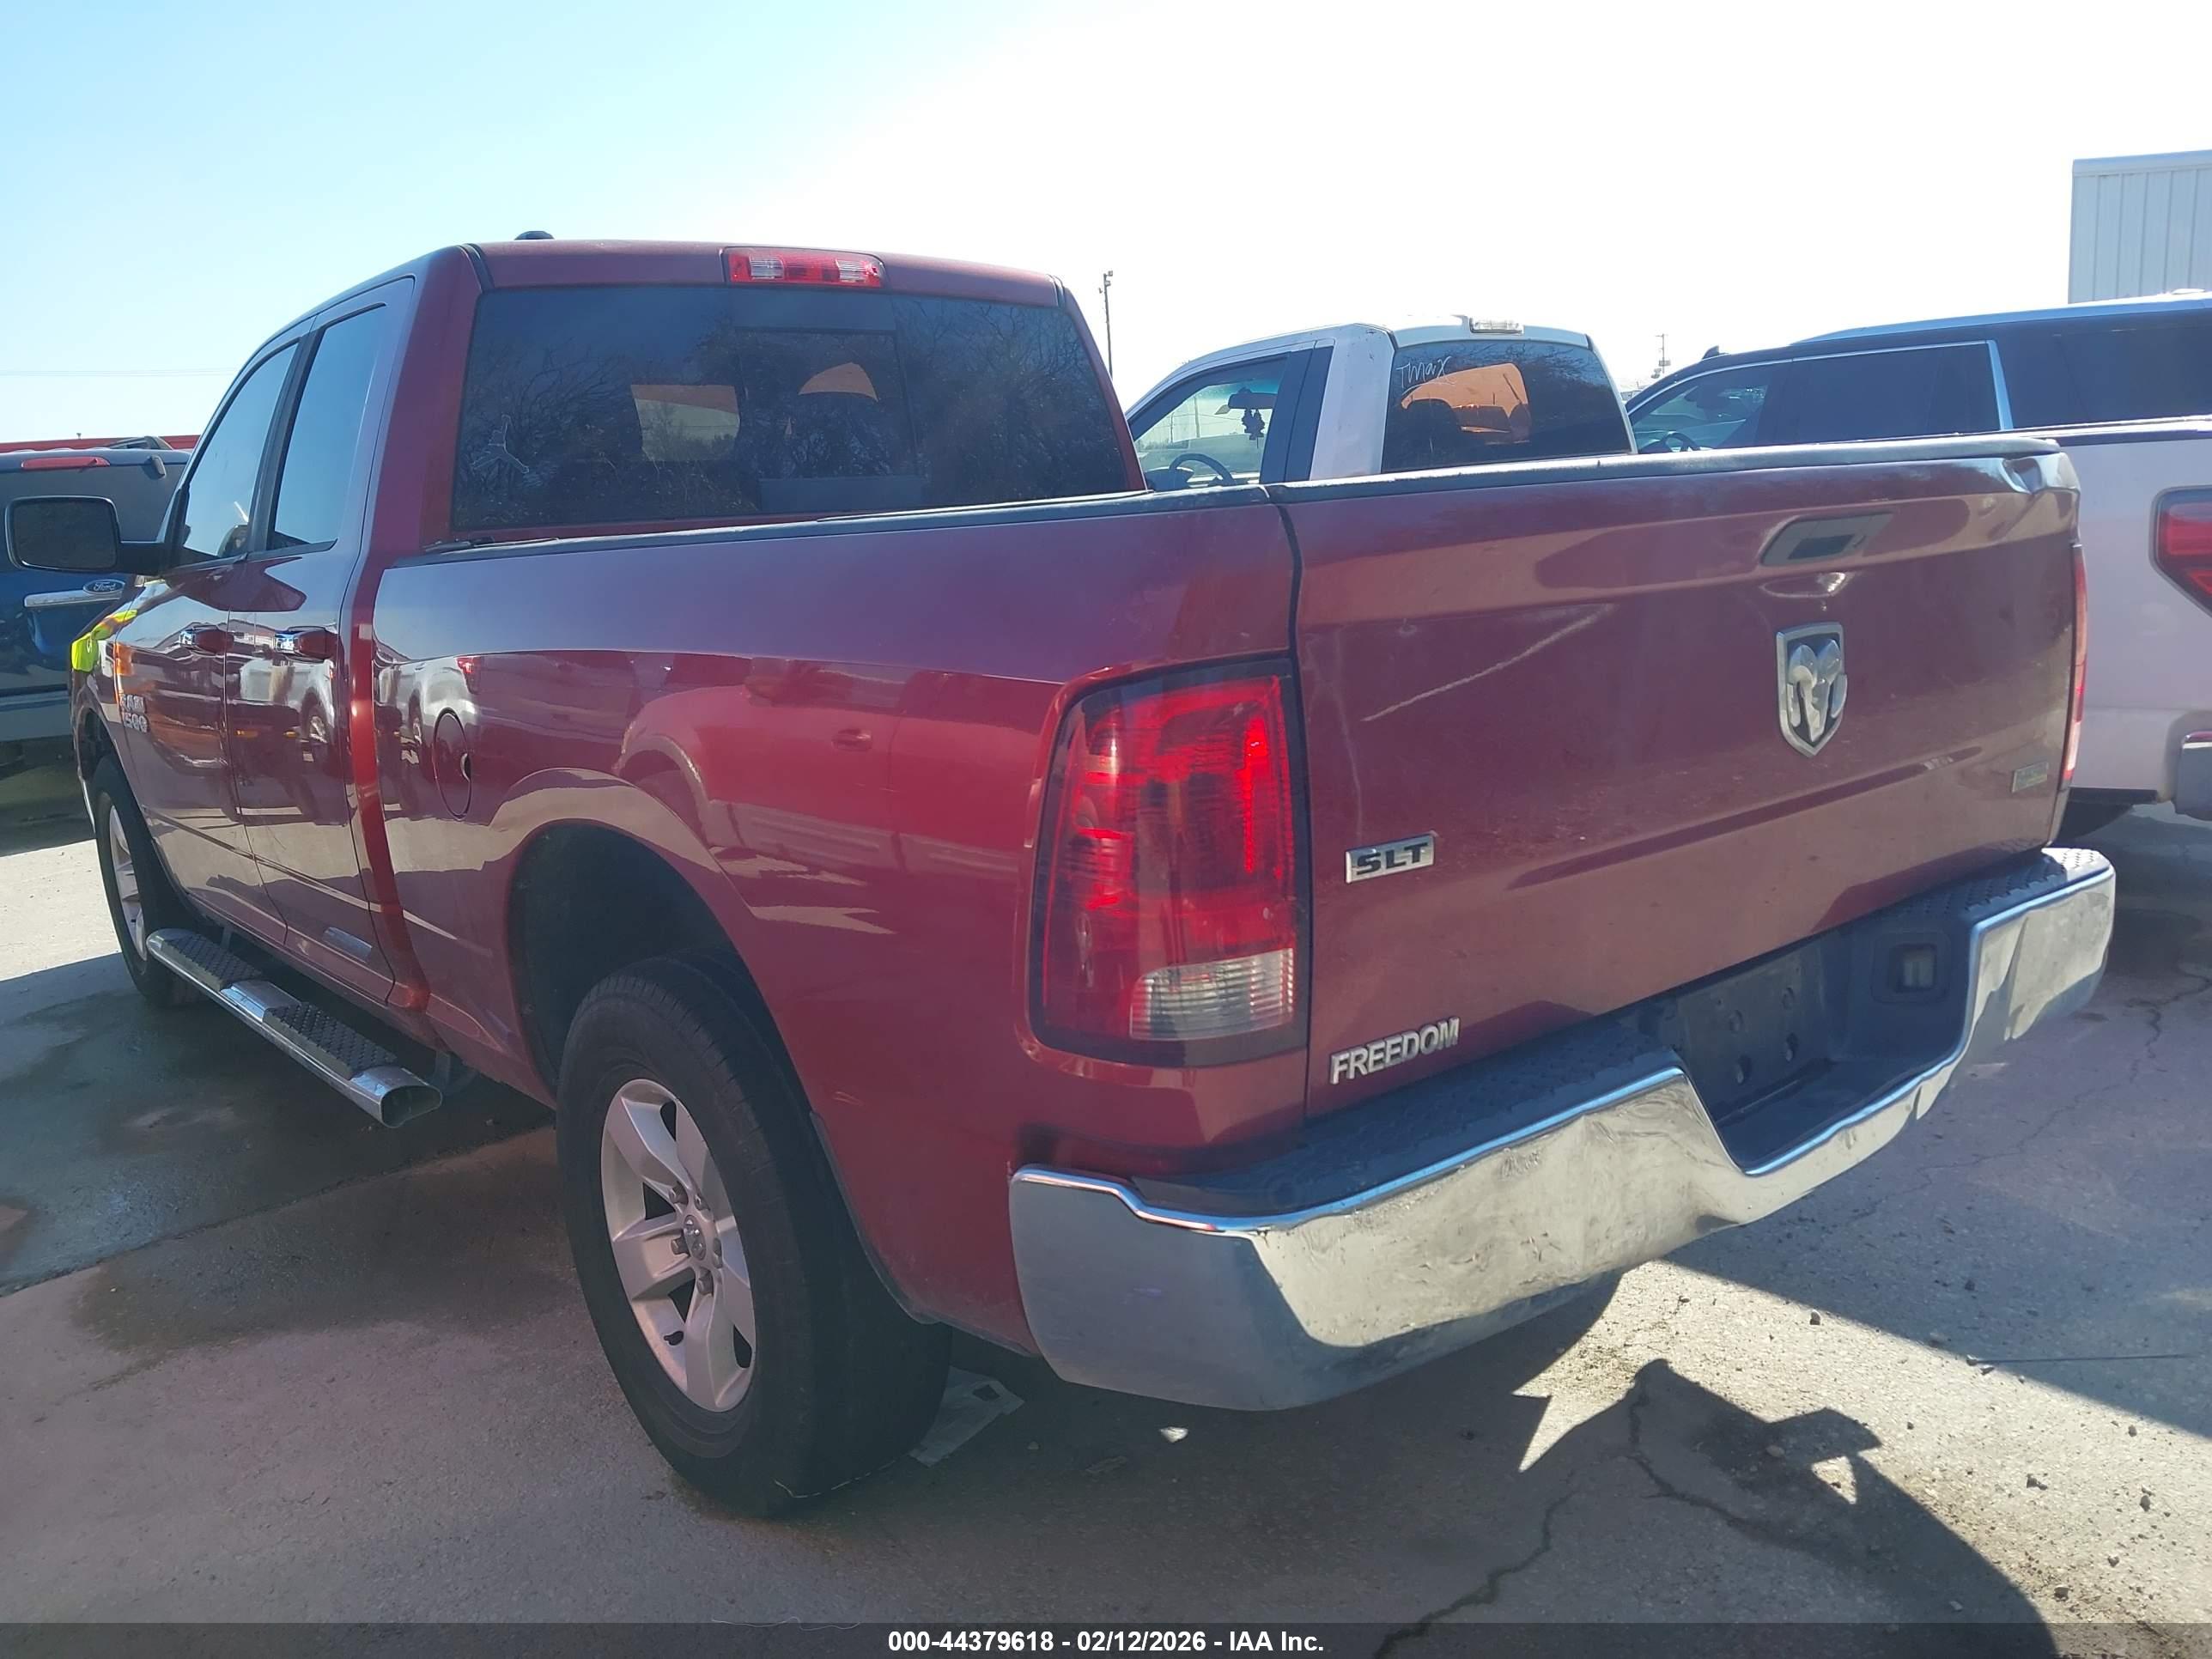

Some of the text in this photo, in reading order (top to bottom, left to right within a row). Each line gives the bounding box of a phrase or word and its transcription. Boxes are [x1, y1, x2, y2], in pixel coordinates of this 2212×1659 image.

[93, 581, 117, 592] Ford
[1356, 842, 1428, 876] SLT
[1330, 1017, 1460, 1085] FREEDOM
